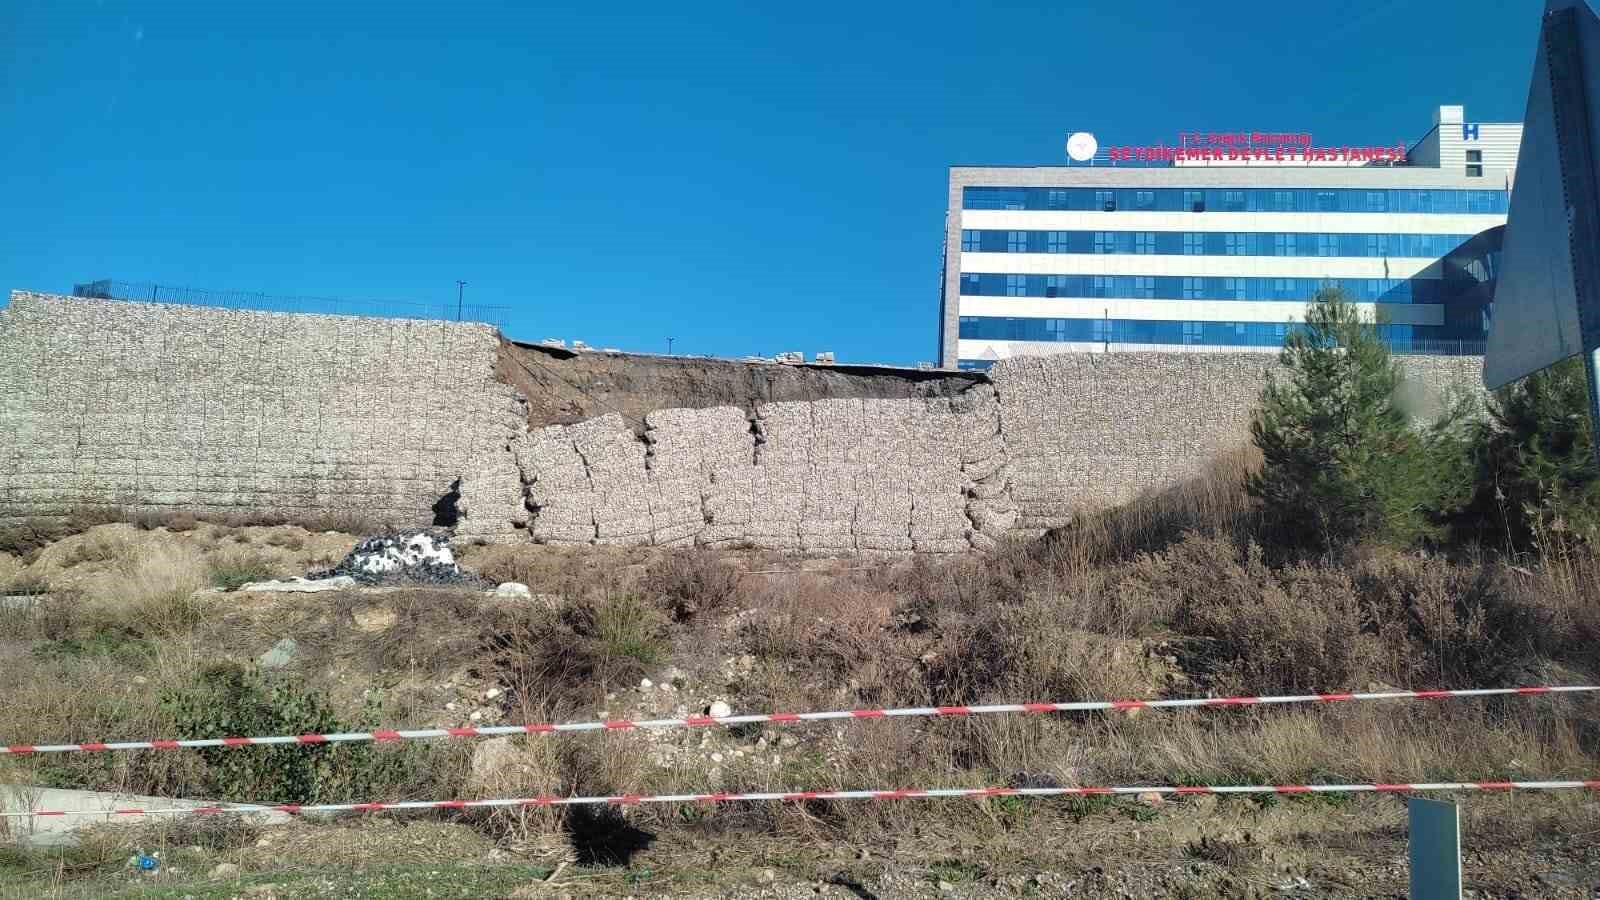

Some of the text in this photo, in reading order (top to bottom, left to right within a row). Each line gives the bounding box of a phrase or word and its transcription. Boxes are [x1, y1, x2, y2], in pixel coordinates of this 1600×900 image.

[1463, 124, 1479, 140] H
[1228, 146, 1296, 161] DEVLET
[1303, 142, 1406, 162] HASTANESİ
